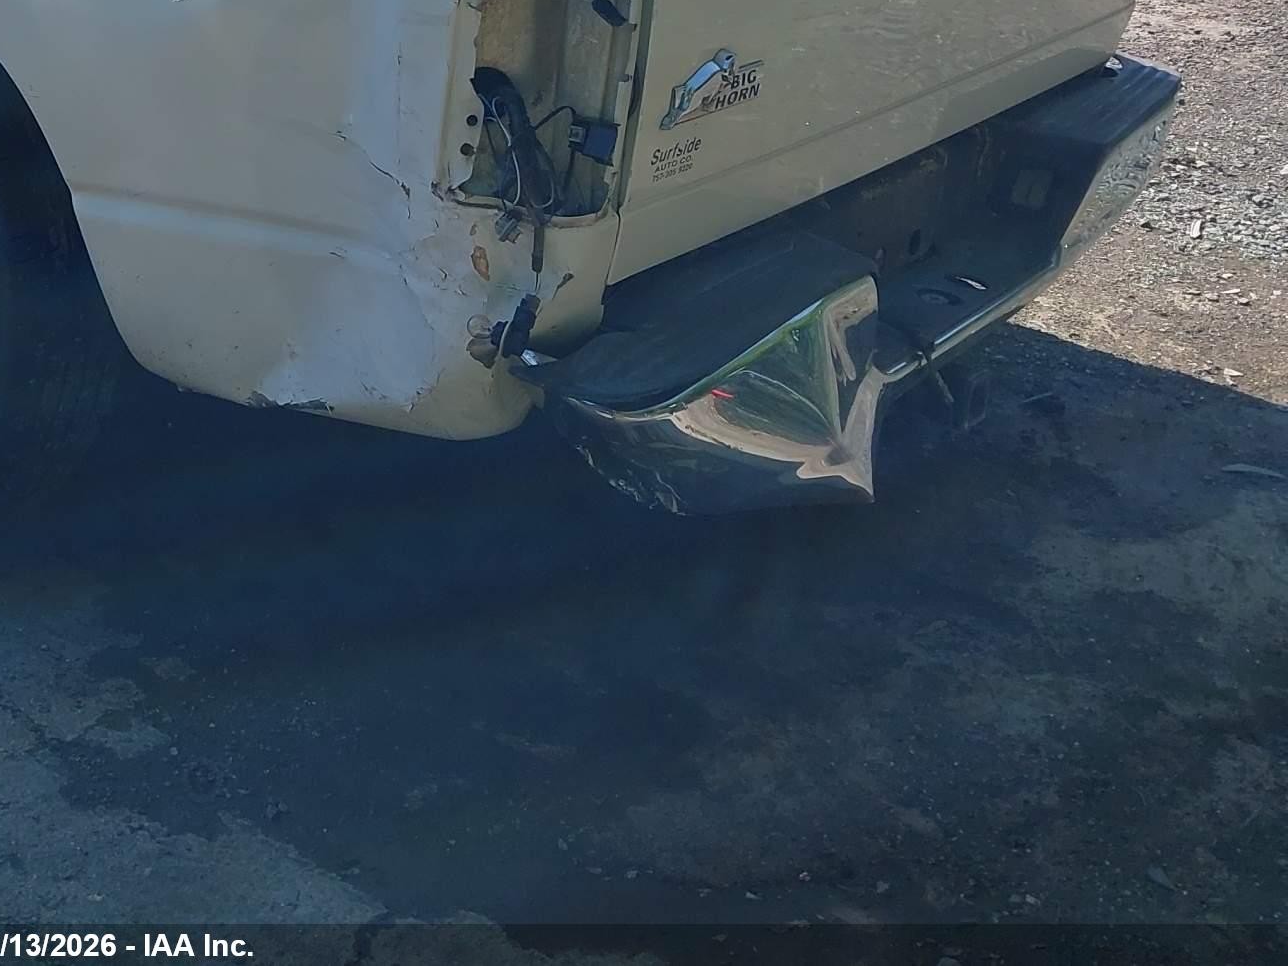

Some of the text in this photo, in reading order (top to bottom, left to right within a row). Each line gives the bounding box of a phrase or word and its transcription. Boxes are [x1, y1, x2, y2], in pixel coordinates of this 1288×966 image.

[730, 69, 757, 90] BIG
[715, 83, 761, 109] HORN
[650, 136, 702, 166] Surfside
[654, 159, 678, 174] AUTO
